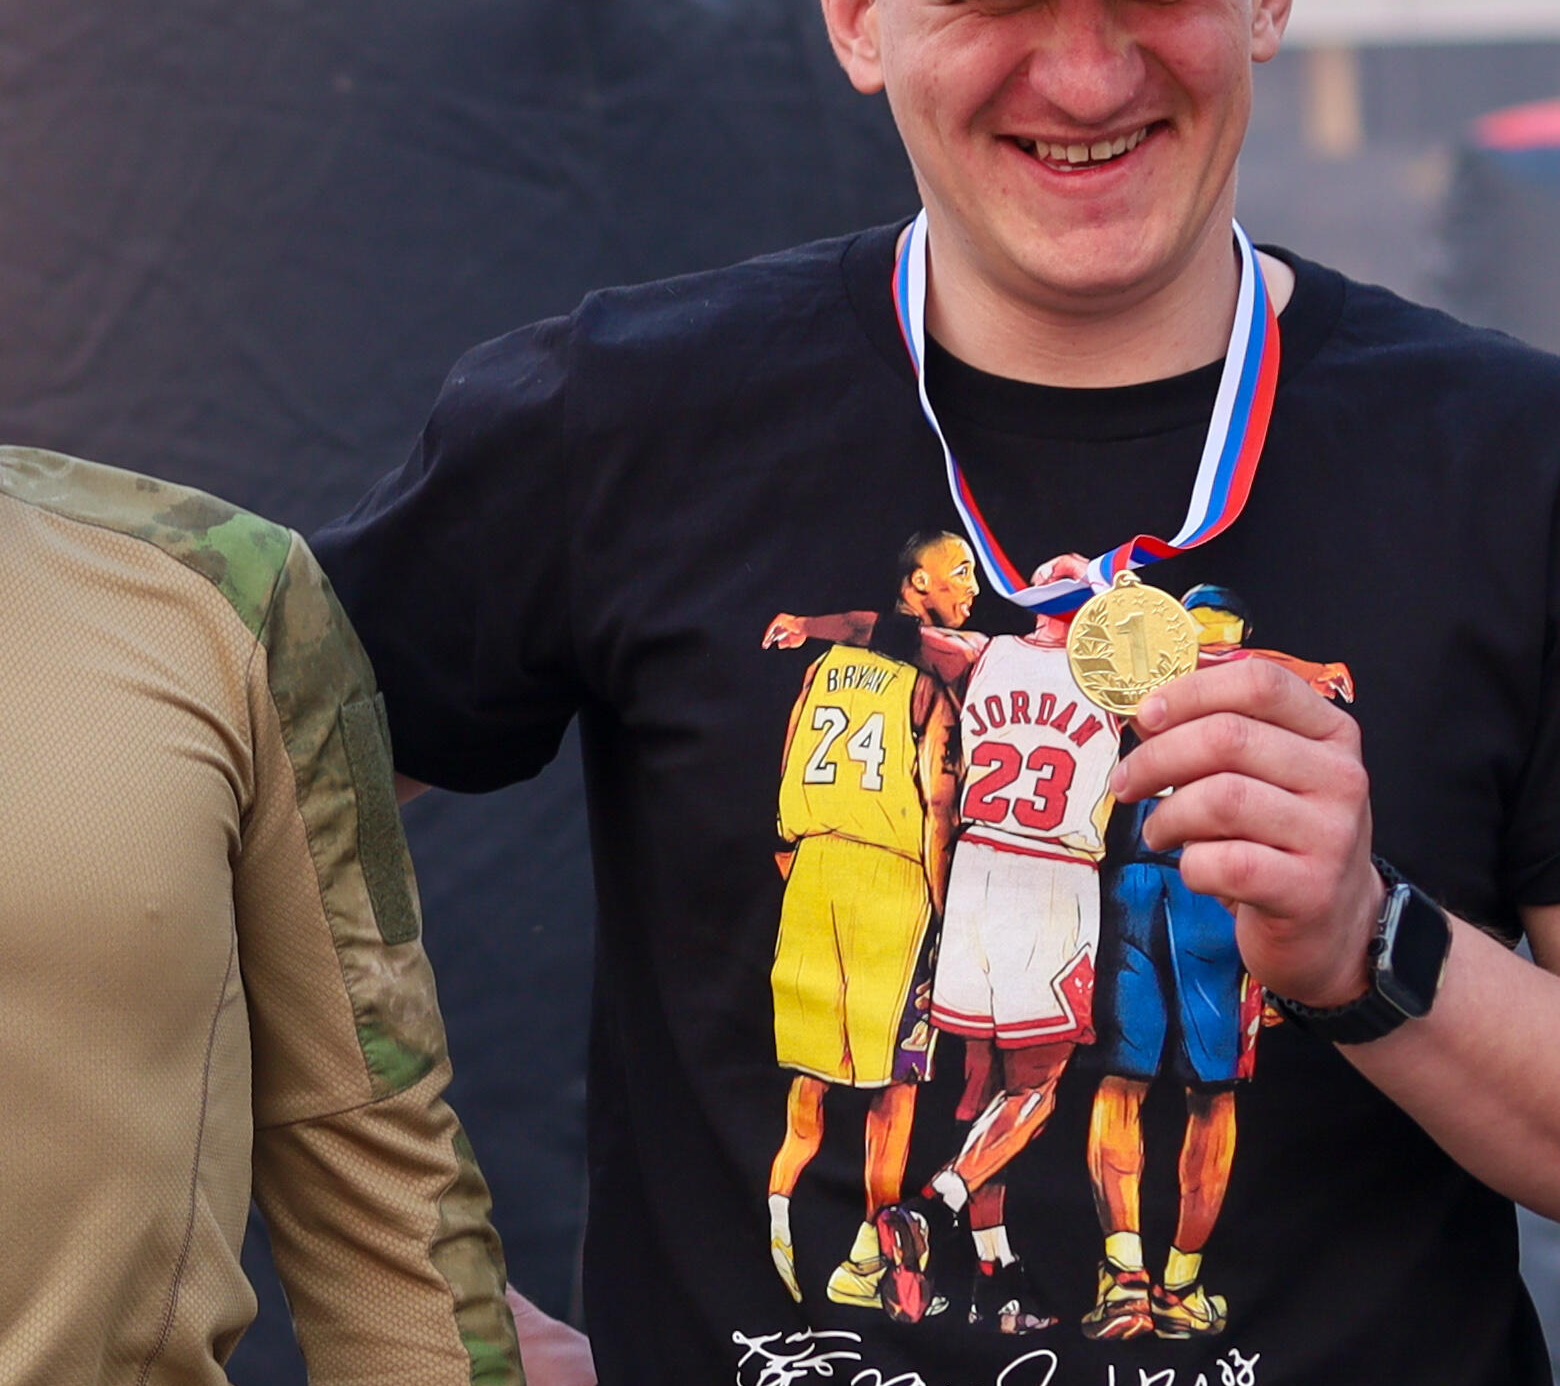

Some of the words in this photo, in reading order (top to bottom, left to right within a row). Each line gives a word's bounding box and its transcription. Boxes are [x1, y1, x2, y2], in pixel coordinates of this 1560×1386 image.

[827, 665, 899, 695] BRYANT
[1115, 611, 1150, 681] 1
[803, 706, 886, 791] 24
[966, 690, 1103, 748] JORDAN
[963, 741, 1077, 831] 23
